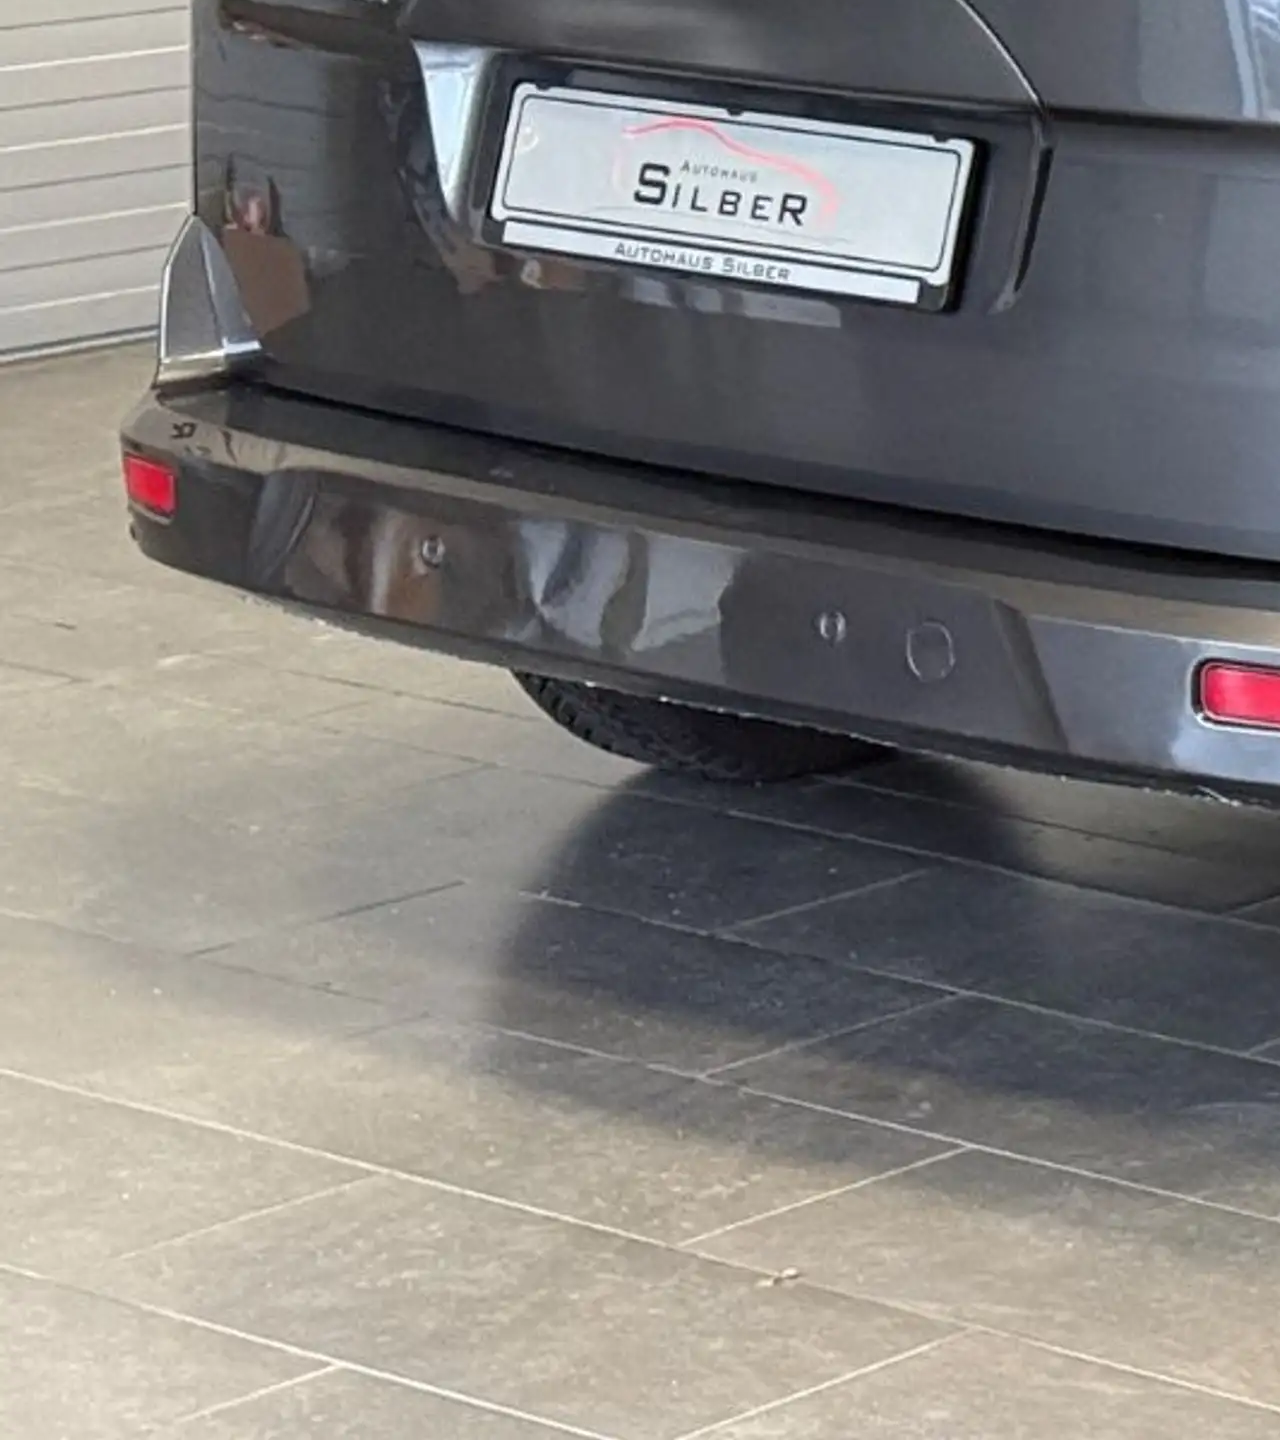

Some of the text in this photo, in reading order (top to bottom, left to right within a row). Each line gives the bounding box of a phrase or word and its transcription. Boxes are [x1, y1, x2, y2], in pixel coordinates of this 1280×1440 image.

[679, 159, 758, 183] AUTOHAUS
[633, 162, 809, 227] SILBER
[614, 242, 792, 281] AUTOHAUS SILBER
